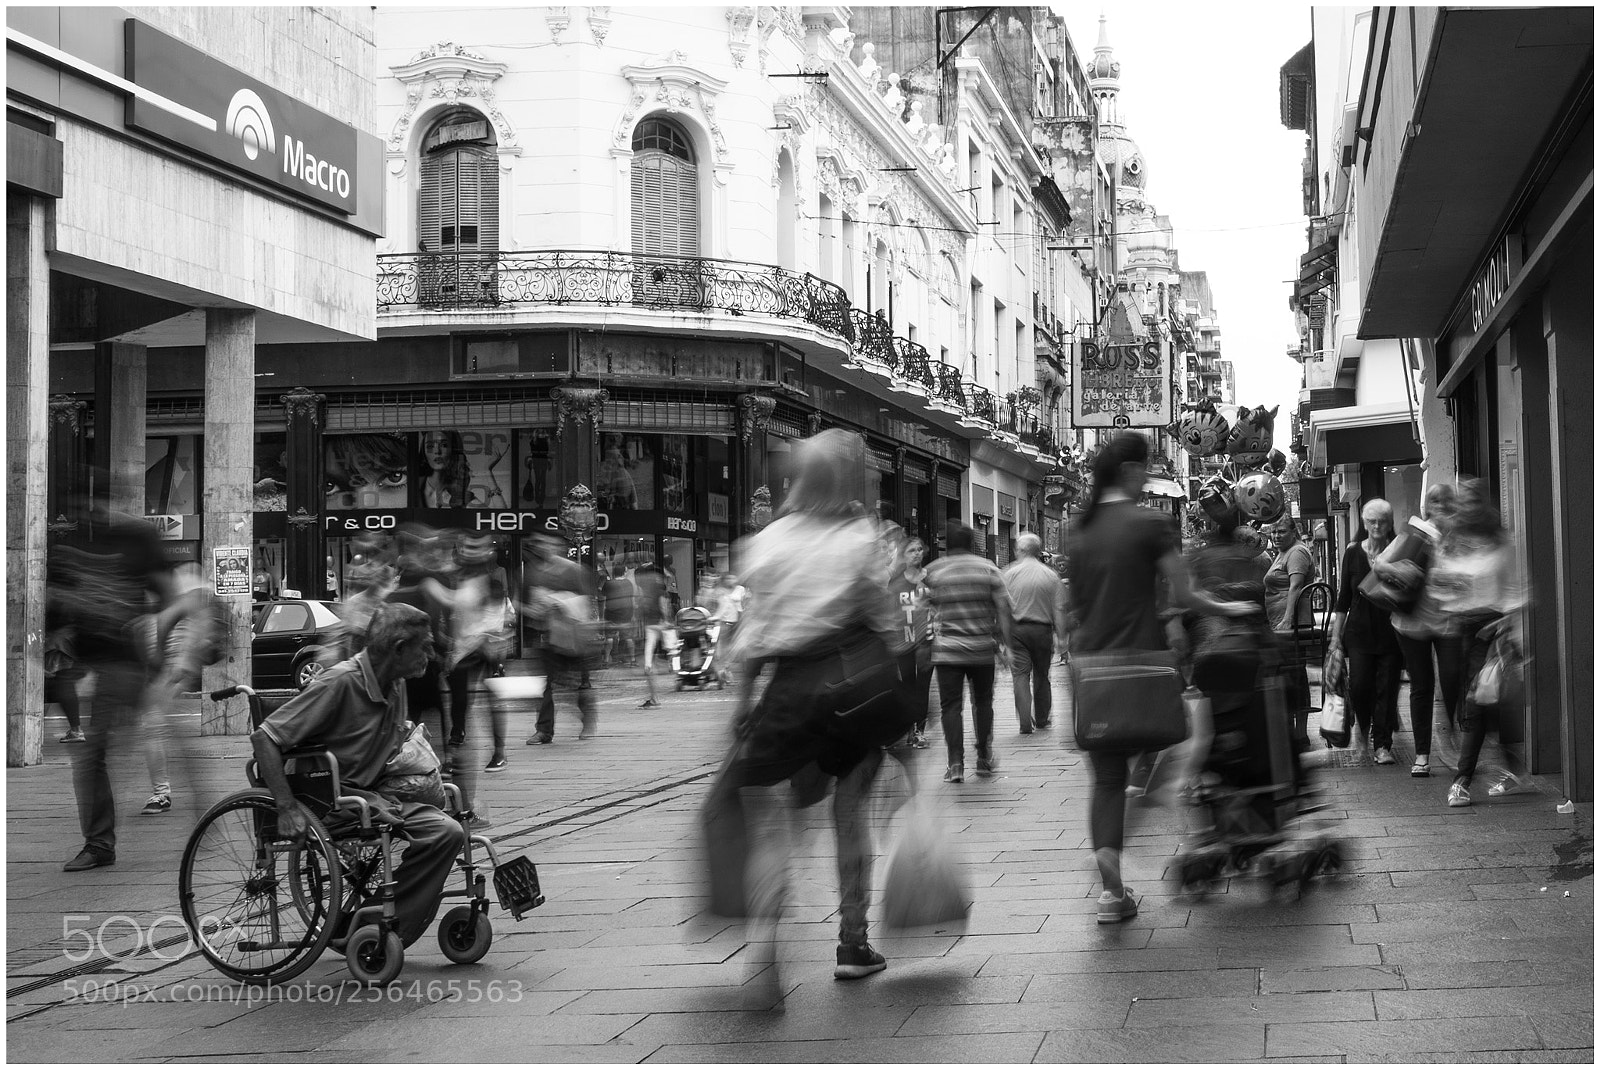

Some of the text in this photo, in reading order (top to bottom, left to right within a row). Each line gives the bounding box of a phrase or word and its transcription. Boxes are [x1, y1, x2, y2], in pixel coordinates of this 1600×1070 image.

[283, 134, 350, 199] Macro
[1081, 342, 1159, 370] ROSS
[1101, 399, 1118, 412] de
